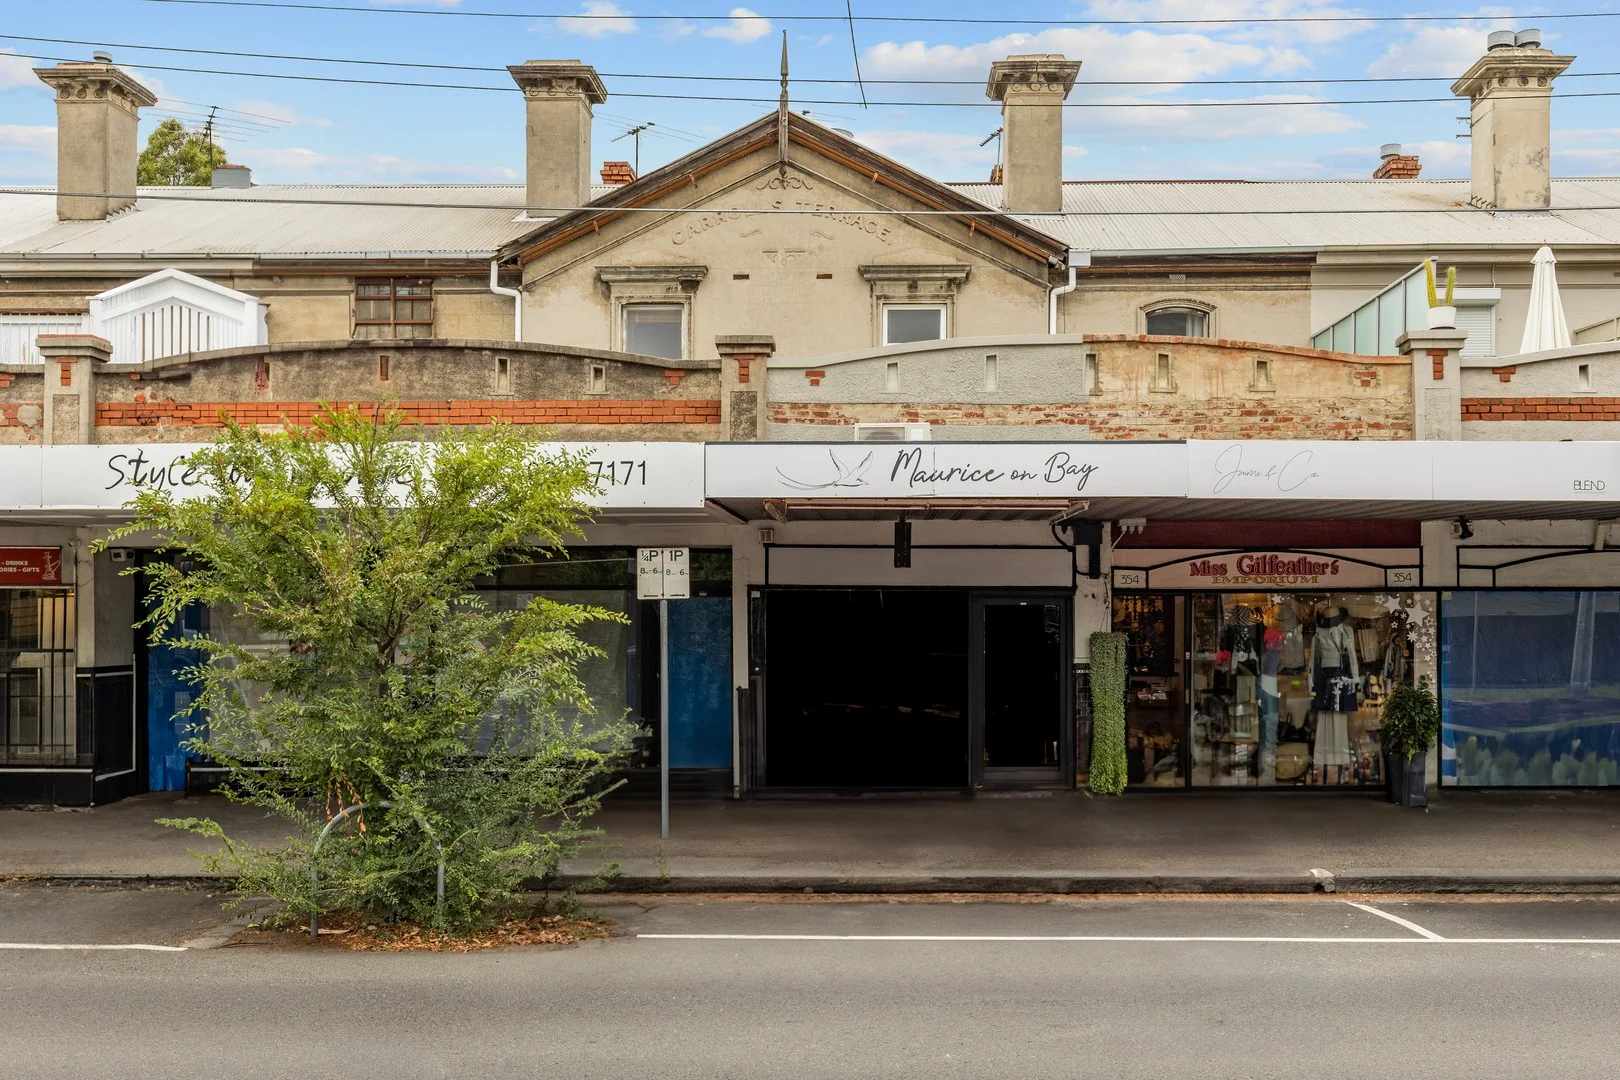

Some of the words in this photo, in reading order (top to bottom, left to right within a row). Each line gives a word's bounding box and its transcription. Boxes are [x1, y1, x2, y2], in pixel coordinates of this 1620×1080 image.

[890, 447, 1005, 488] Maurice
[1010, 469, 1038, 481] on
[1044, 451, 1099, 491] Bay
[1573, 479, 1606, 491] BLEND
[669, 550, 684, 561] 1P
[1189, 559, 1228, 576] Miss
[1236, 553, 1340, 576] Gilfeather's
[1120, 574, 1140, 585] 354
[1212, 575, 1320, 587] EMPORIUM
[1393, 572, 1413, 583] 354
